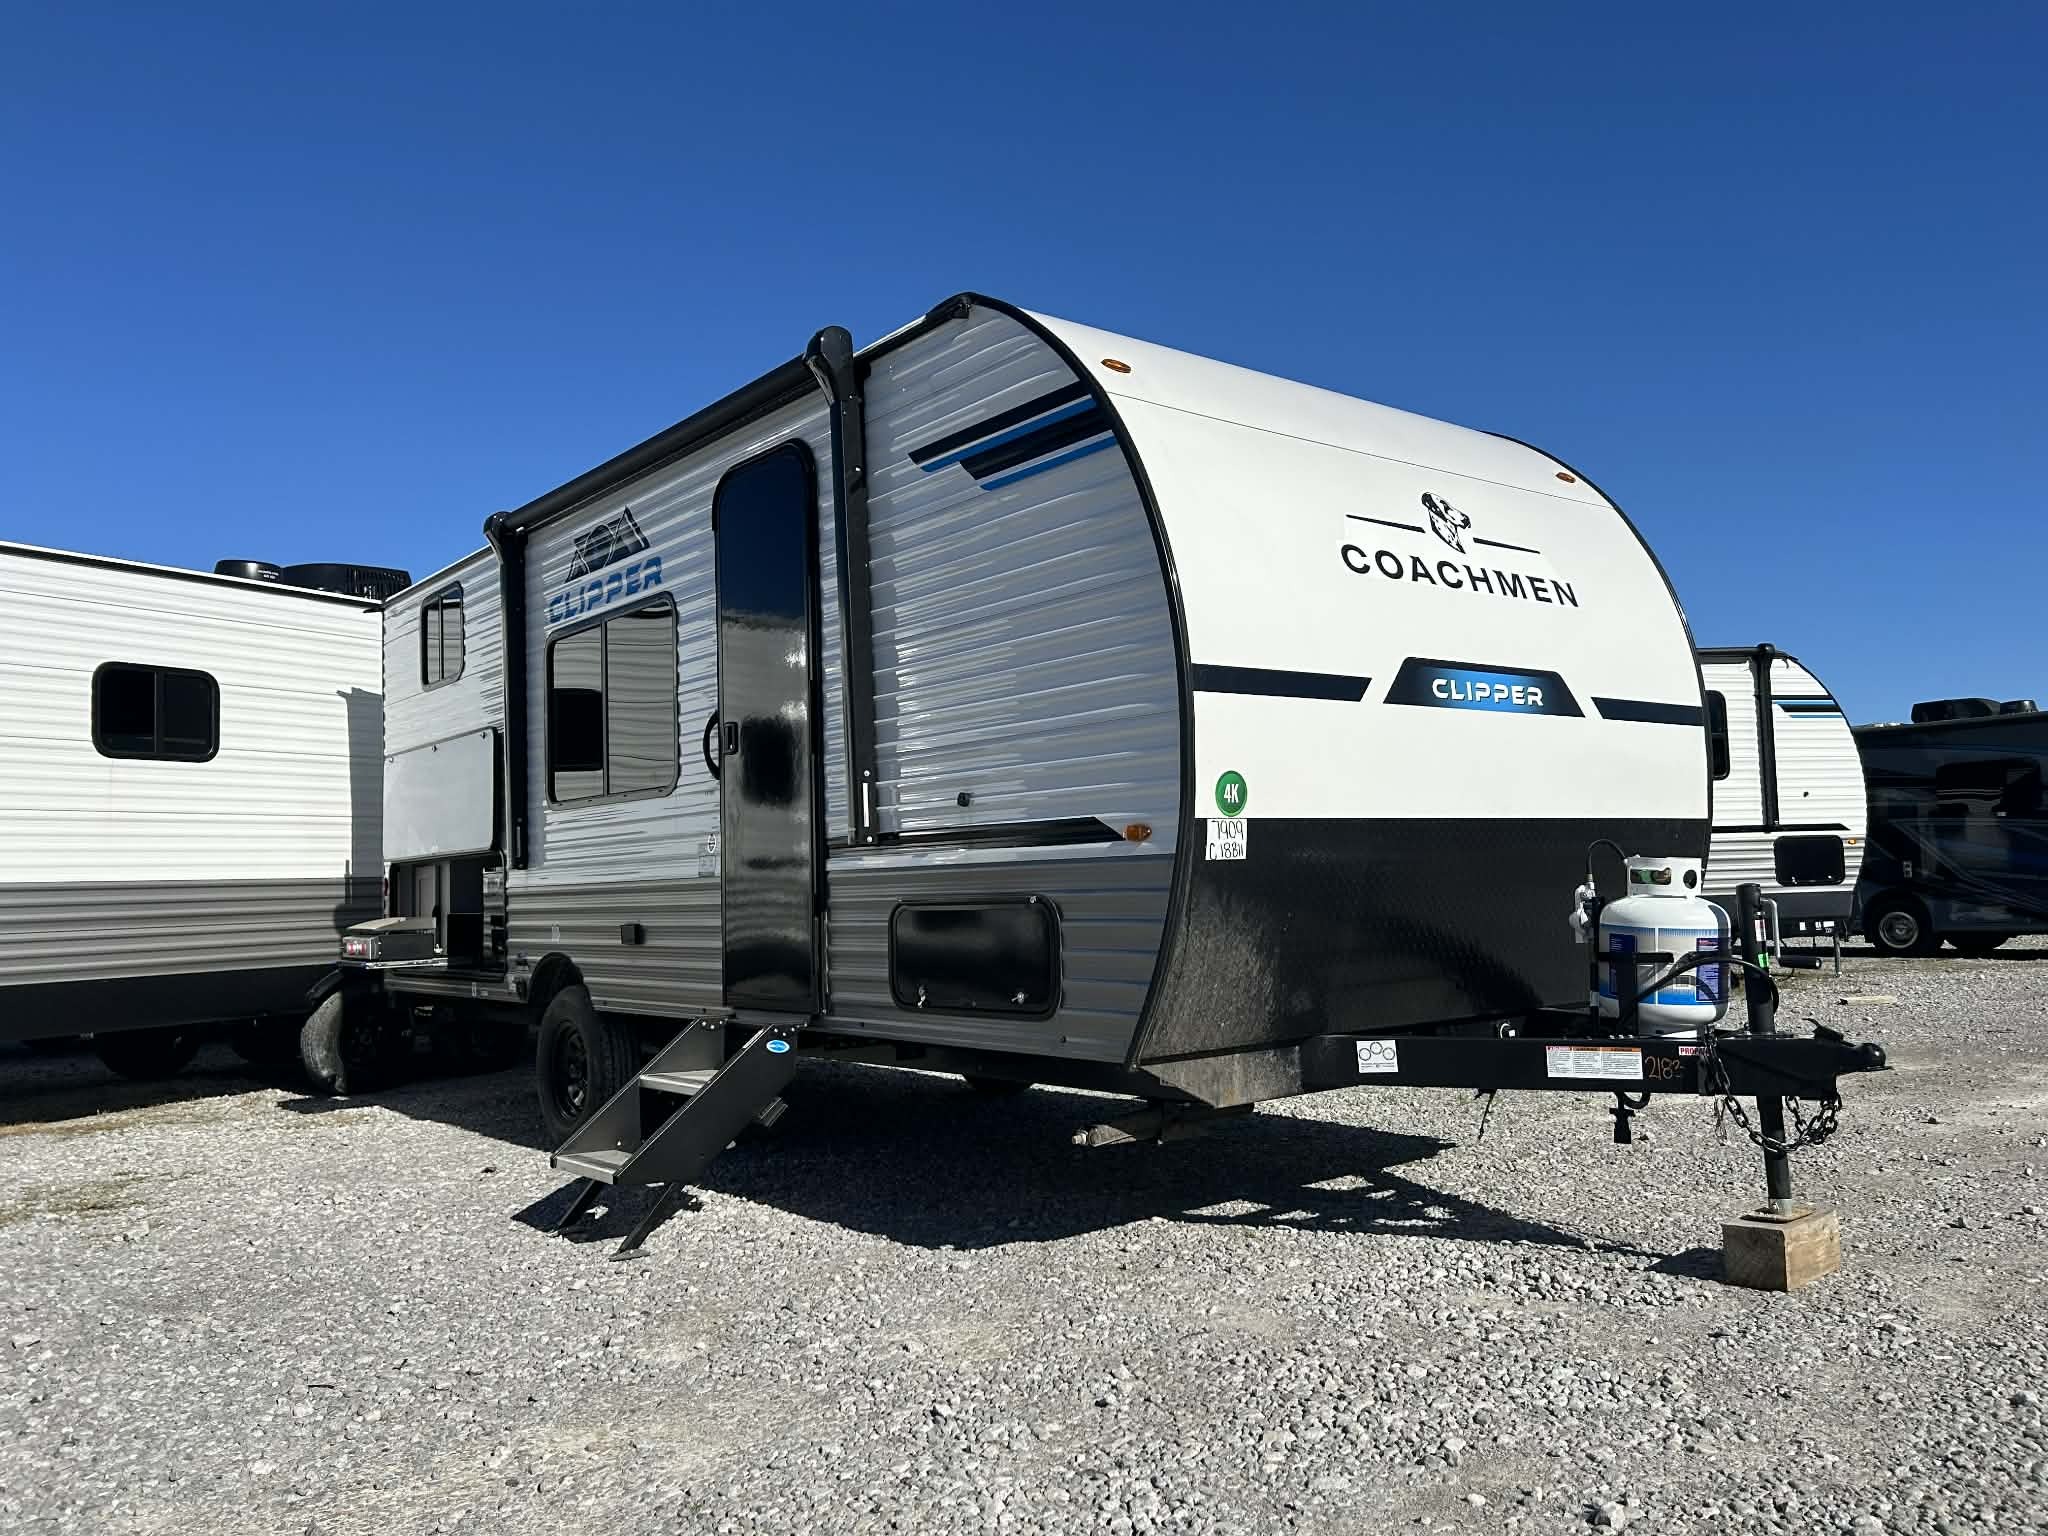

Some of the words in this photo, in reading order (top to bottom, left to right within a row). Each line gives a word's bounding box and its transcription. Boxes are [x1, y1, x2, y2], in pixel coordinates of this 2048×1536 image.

[549, 556, 663, 624] CLIPPER
[1340, 543, 1579, 608] COACHMEN
[1431, 678, 1544, 706] CLIPPER
[1223, 783, 1240, 803] 4K
